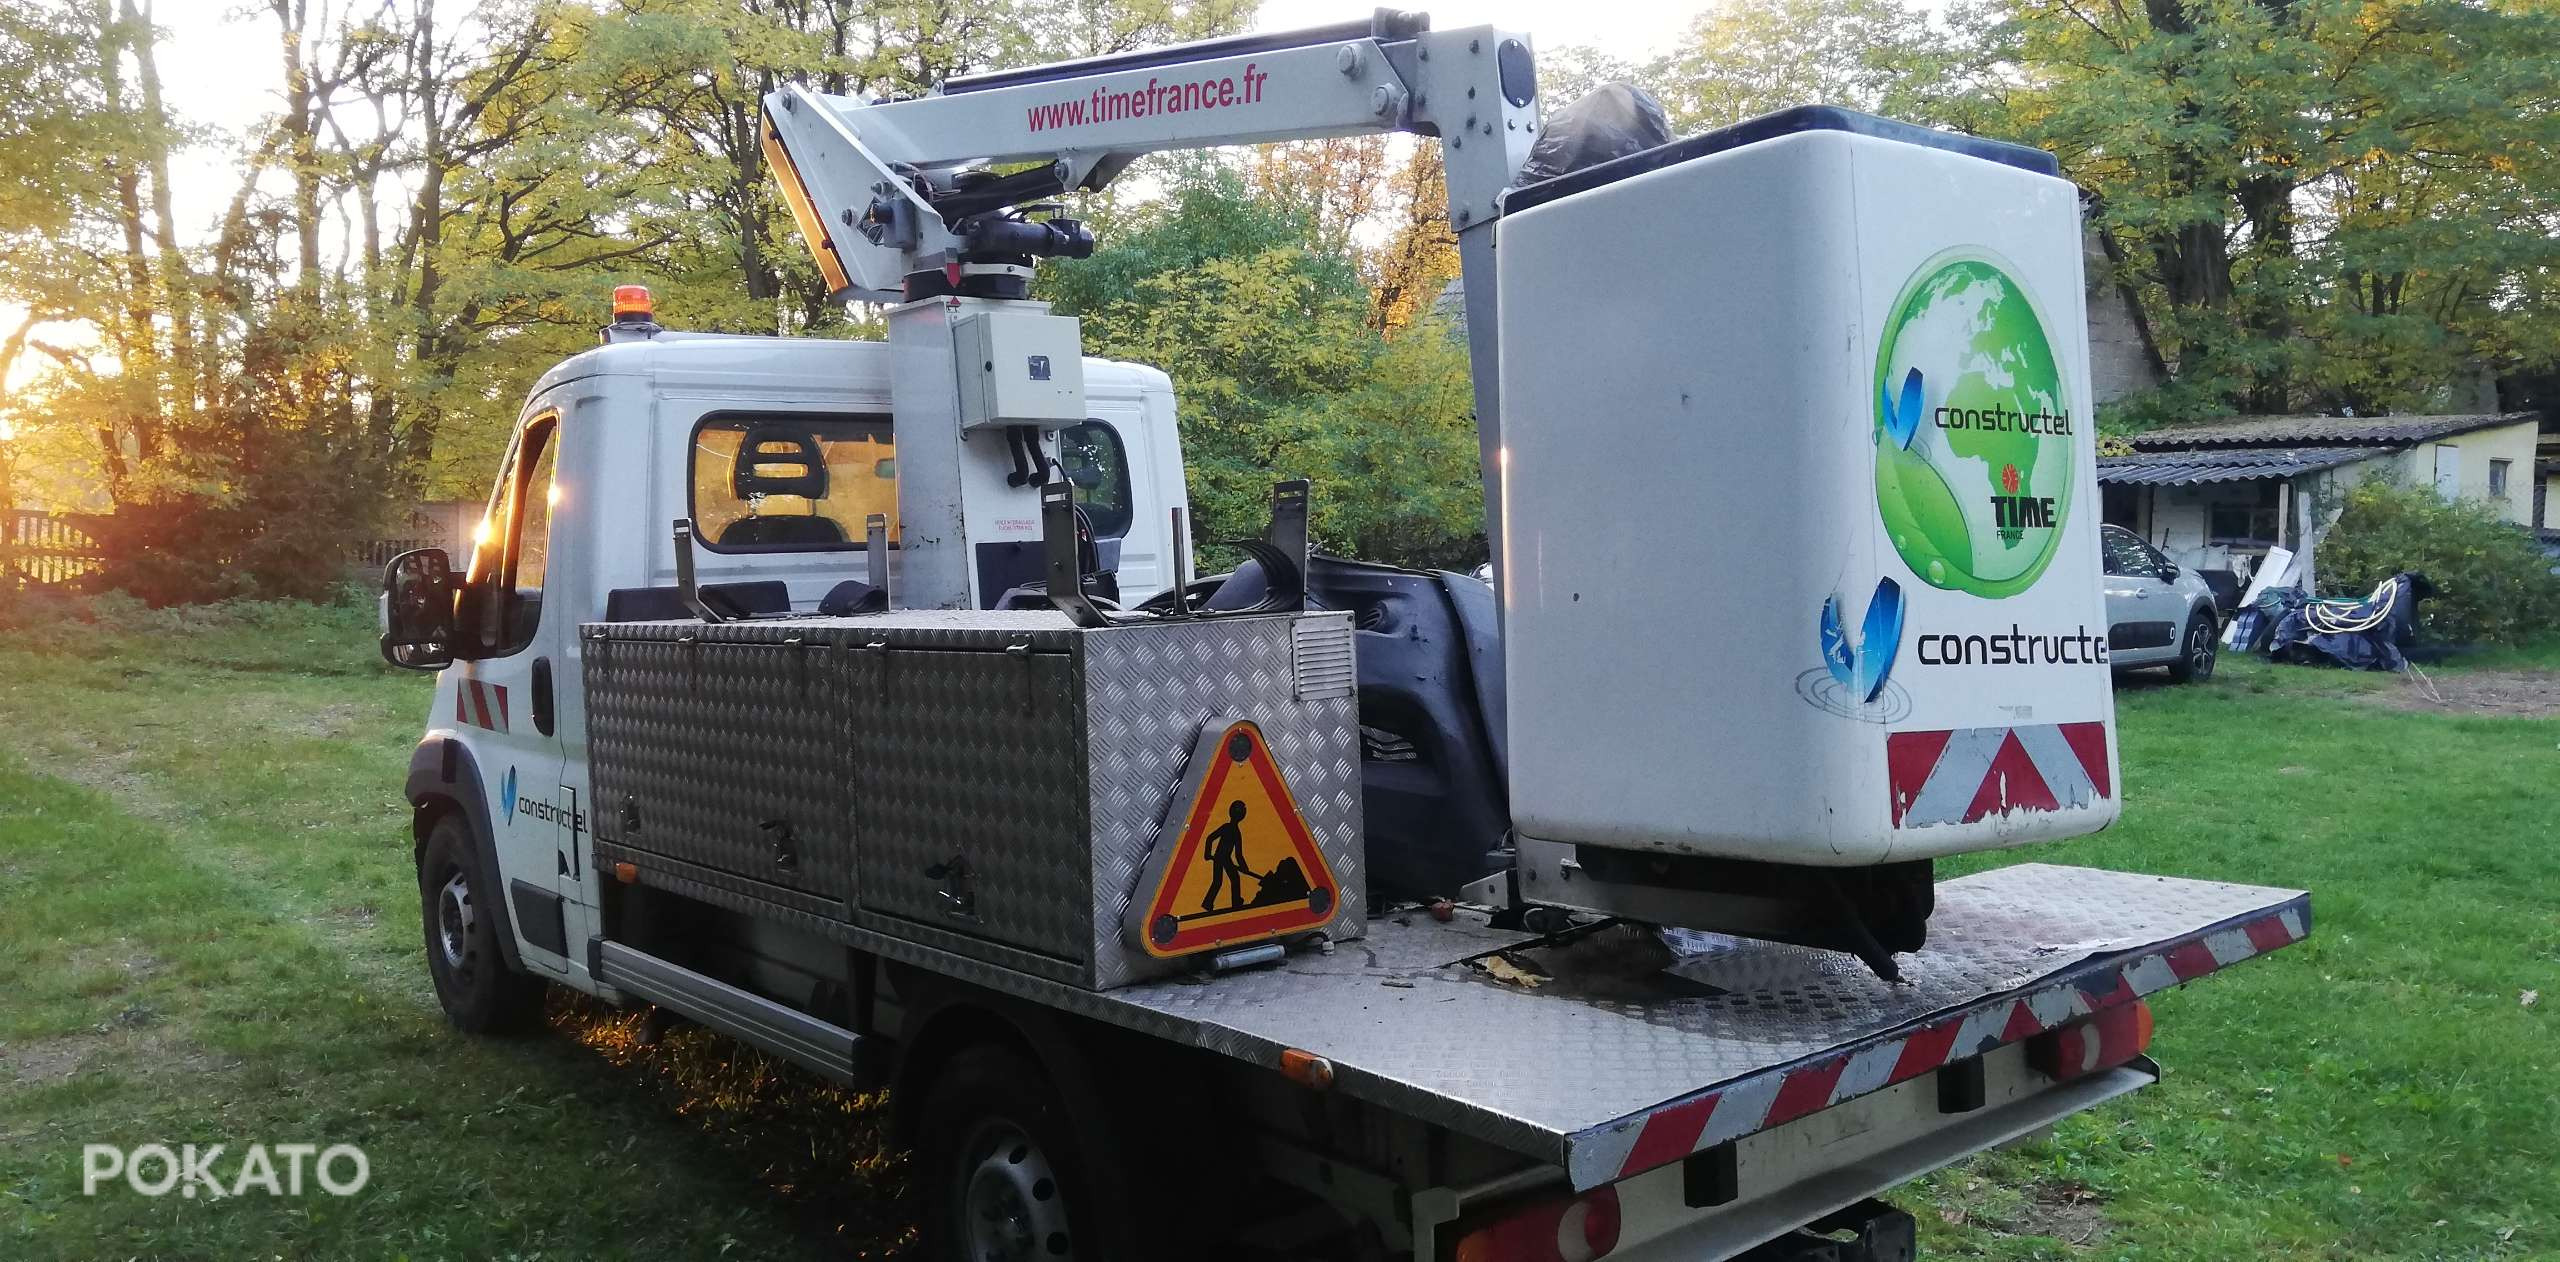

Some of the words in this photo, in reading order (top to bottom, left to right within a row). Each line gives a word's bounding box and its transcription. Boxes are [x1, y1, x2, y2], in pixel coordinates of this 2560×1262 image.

[1027, 63, 1268, 132] www.timefrance.fr
[1934, 403, 2073, 436] constructel
[1990, 496, 2056, 528] TIME
[1996, 530, 2024, 540] FRANCE
[518, 796, 588, 833] constructel
